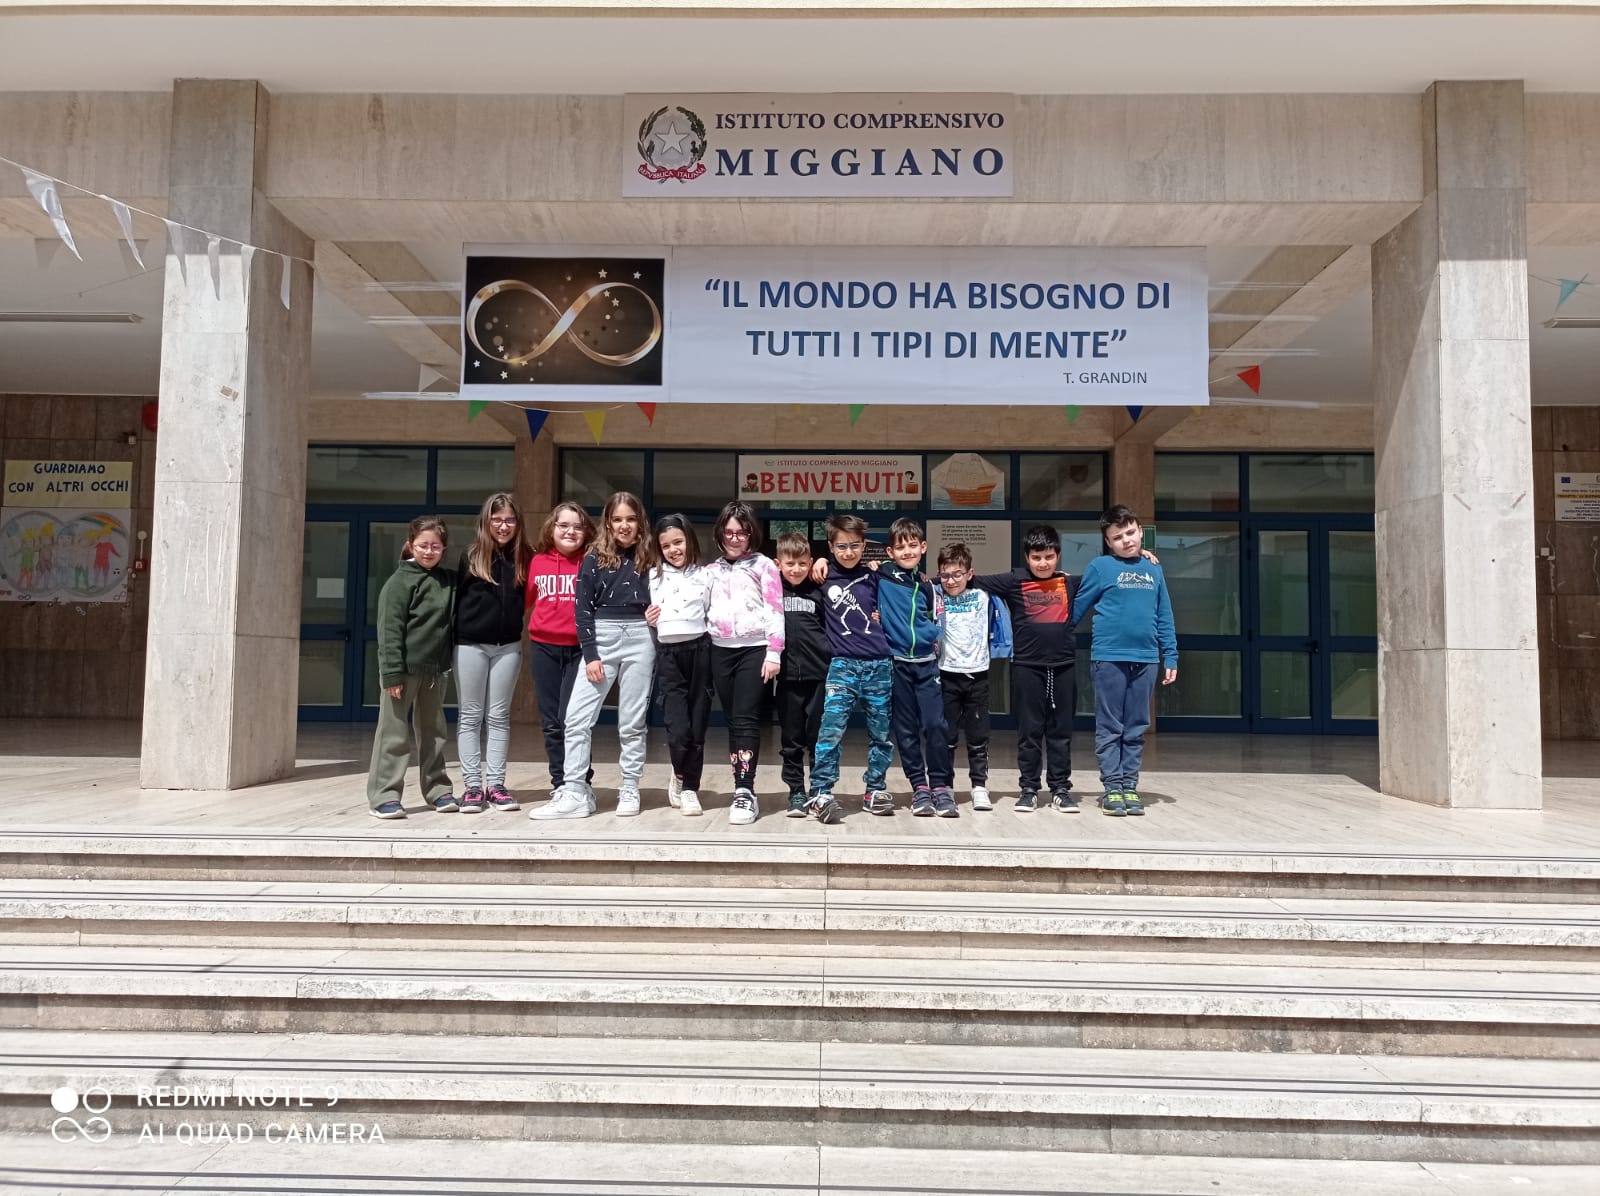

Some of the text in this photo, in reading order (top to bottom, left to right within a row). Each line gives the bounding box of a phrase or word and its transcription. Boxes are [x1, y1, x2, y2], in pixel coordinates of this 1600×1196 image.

[715, 112, 1005, 129] ISTITUTO COMPRENSIVO
[715, 147, 1004, 177] MIGGIANO
[758, 280, 898, 310] MONDO
[908, 281, 957, 310] HA
[968, 281, 1126, 310] BISOGNO
[1136, 282, 1171, 309] DI
[745, 330, 841, 357] TUTTI
[853, 330, 860, 357] I
[870, 331, 933, 358] TIPI
[944, 331, 977, 359] DI
[1063, 372, 1148, 384] T. GRANDIN
[34, 463, 106, 474] GUARDIAMO
[8, 480, 129, 493] CON ALTRI OCCHI
[759, 471, 904, 494] BENVENUTI
